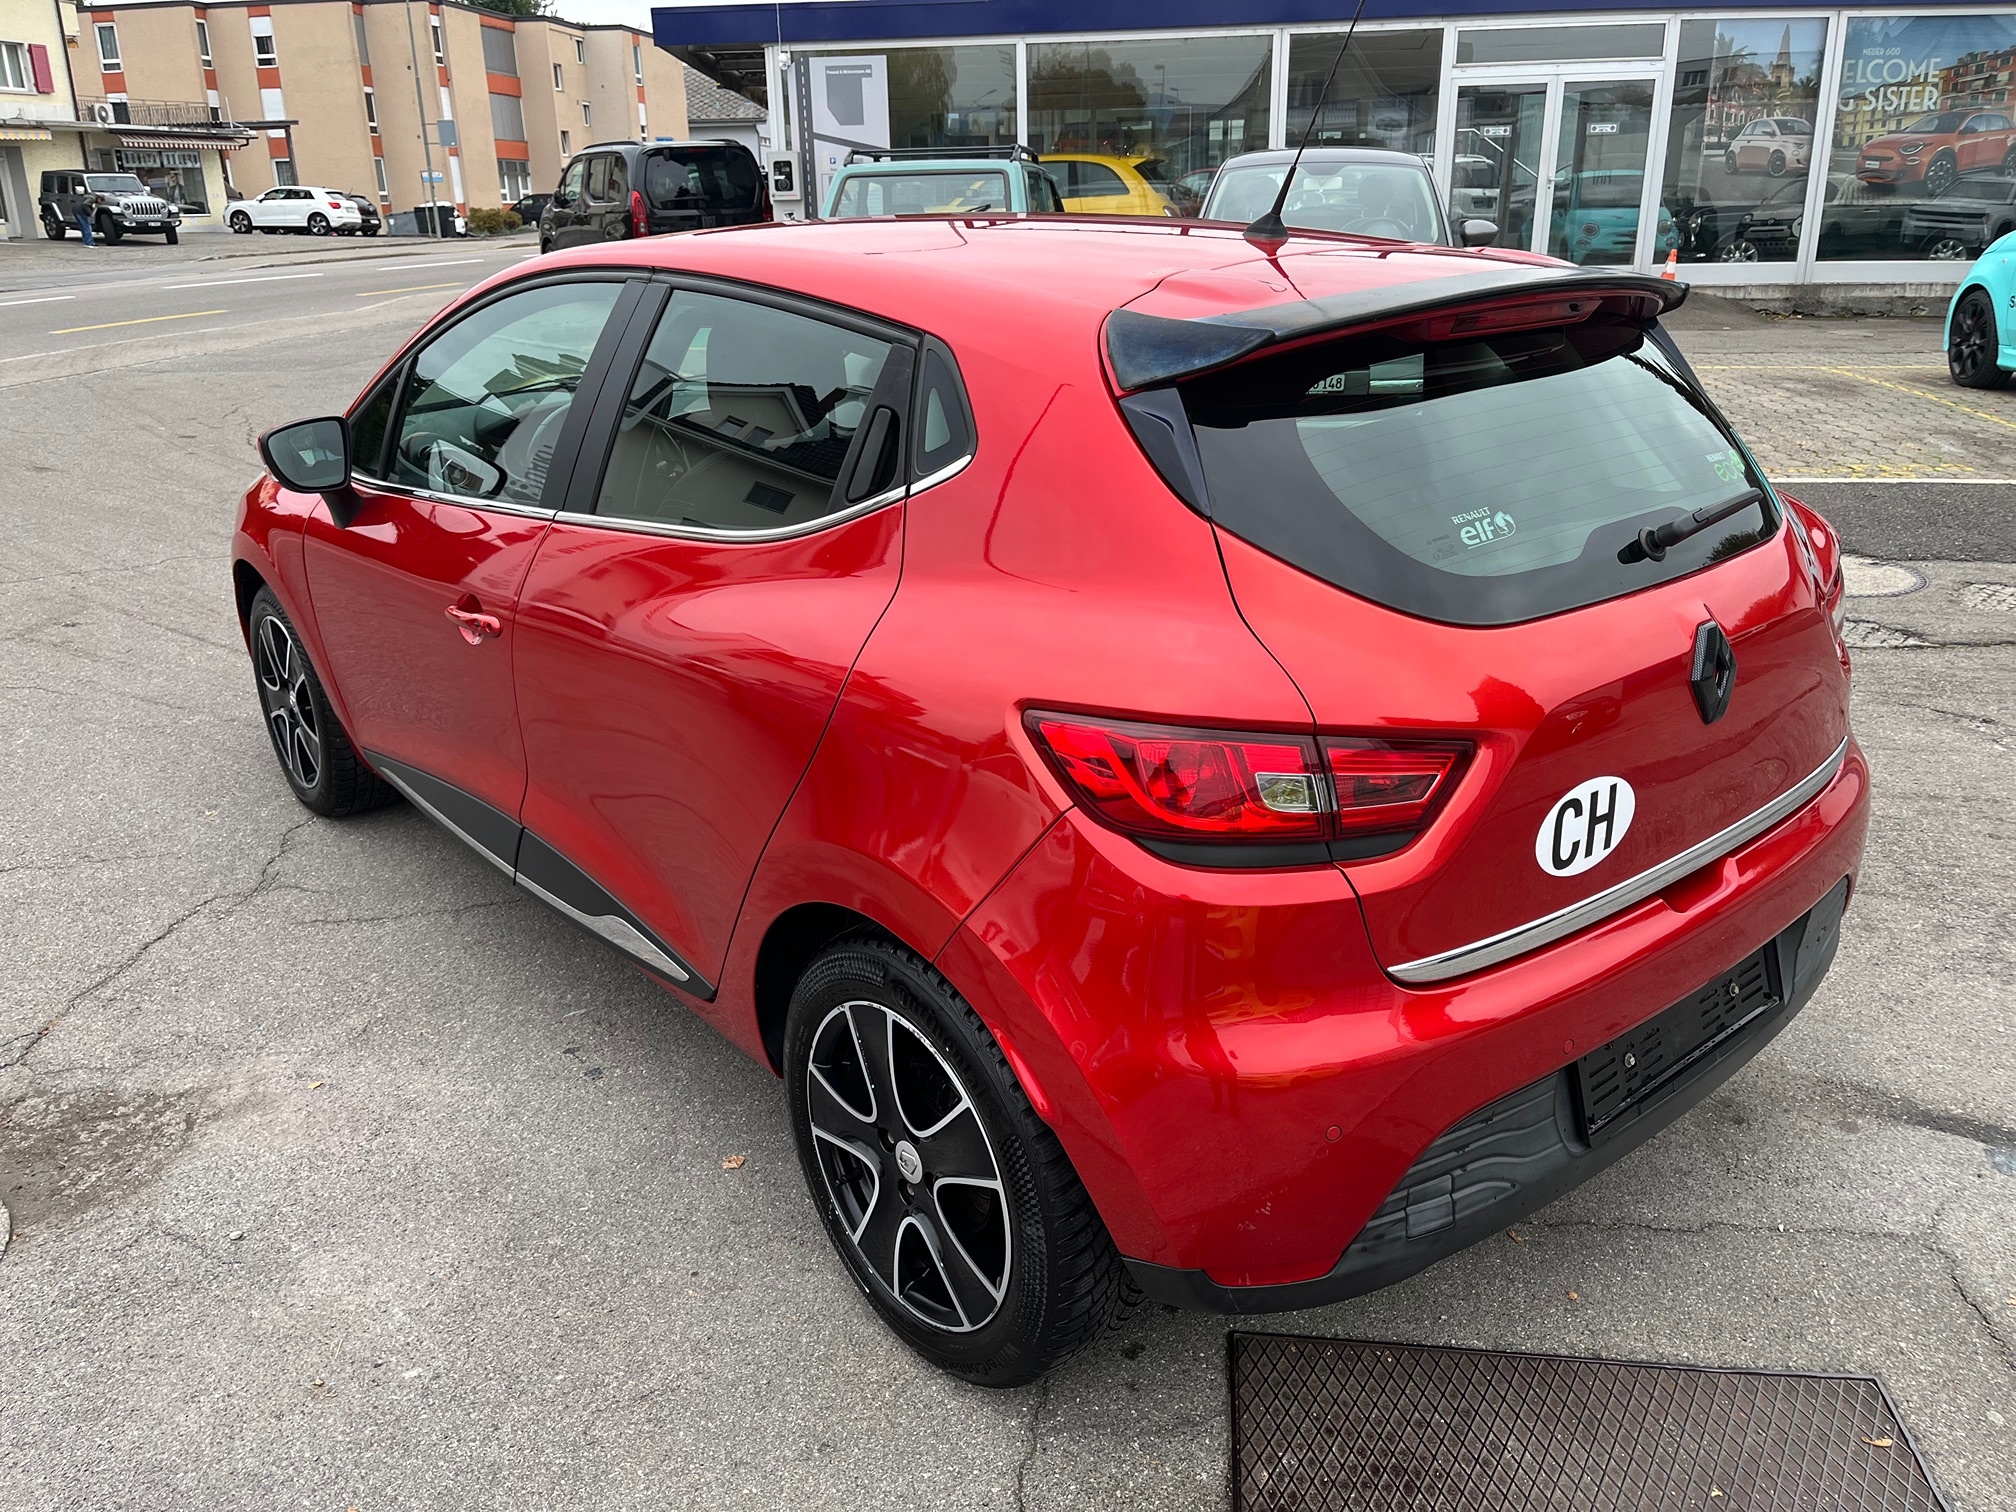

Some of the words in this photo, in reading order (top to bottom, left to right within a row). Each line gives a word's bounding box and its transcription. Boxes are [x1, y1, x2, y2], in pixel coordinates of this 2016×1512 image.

[1863, 48, 1884, 56] NEUER
[1885, 47, 1901, 56] 600
[1842, 57, 1942, 84] ELCOME
[1863, 86, 1938, 111] SISTER
[1451, 506, 1491, 525] RENAULT
[1460, 517, 1495, 545] elf
[1552, 782, 1618, 870] CH
